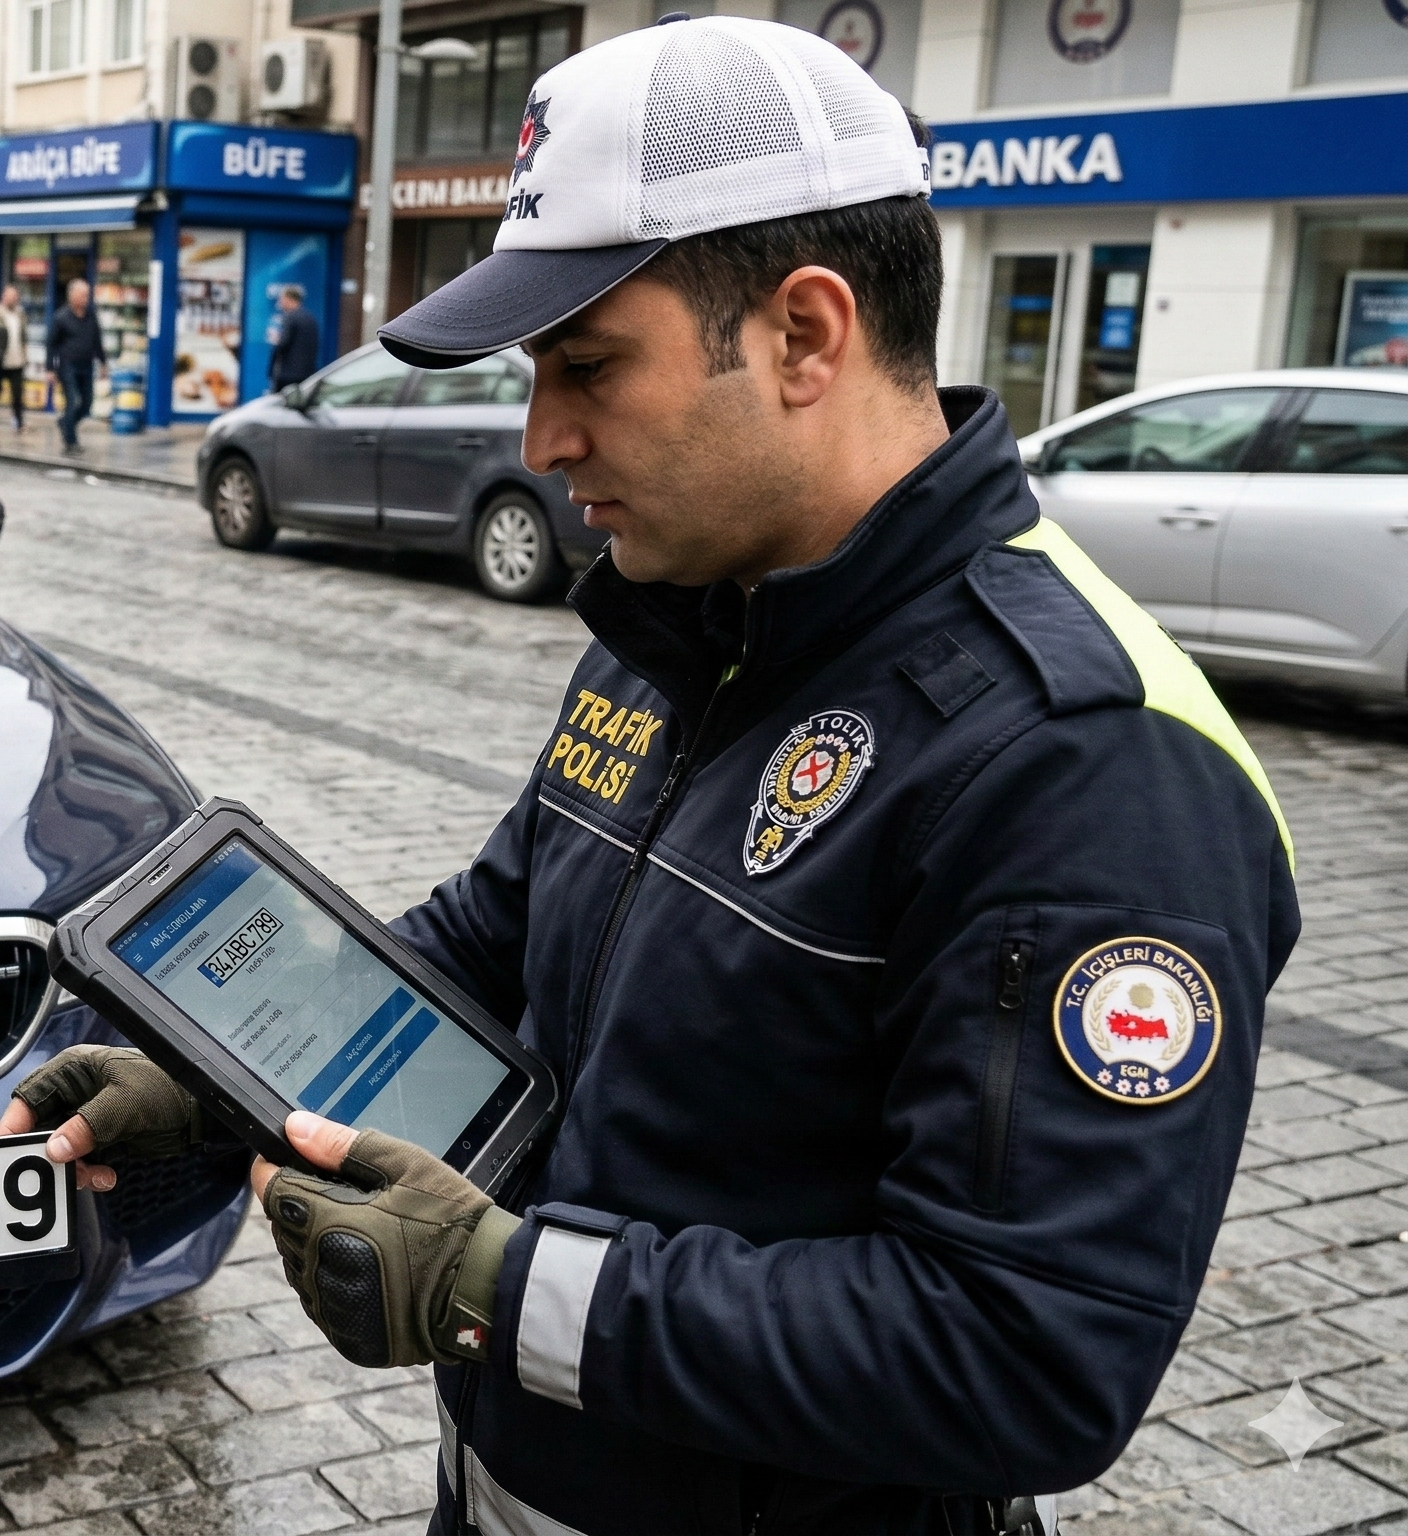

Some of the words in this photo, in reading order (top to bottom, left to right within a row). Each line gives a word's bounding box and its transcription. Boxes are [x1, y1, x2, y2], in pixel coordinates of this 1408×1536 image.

[222, 136, 306, 181] BÜFE
[931, 132, 1124, 190] BANKA
[567, 688, 664, 757] TRAFİK
[546, 732, 637, 805] POLİSİ
[1120, 1064, 1149, 1079] EGM
